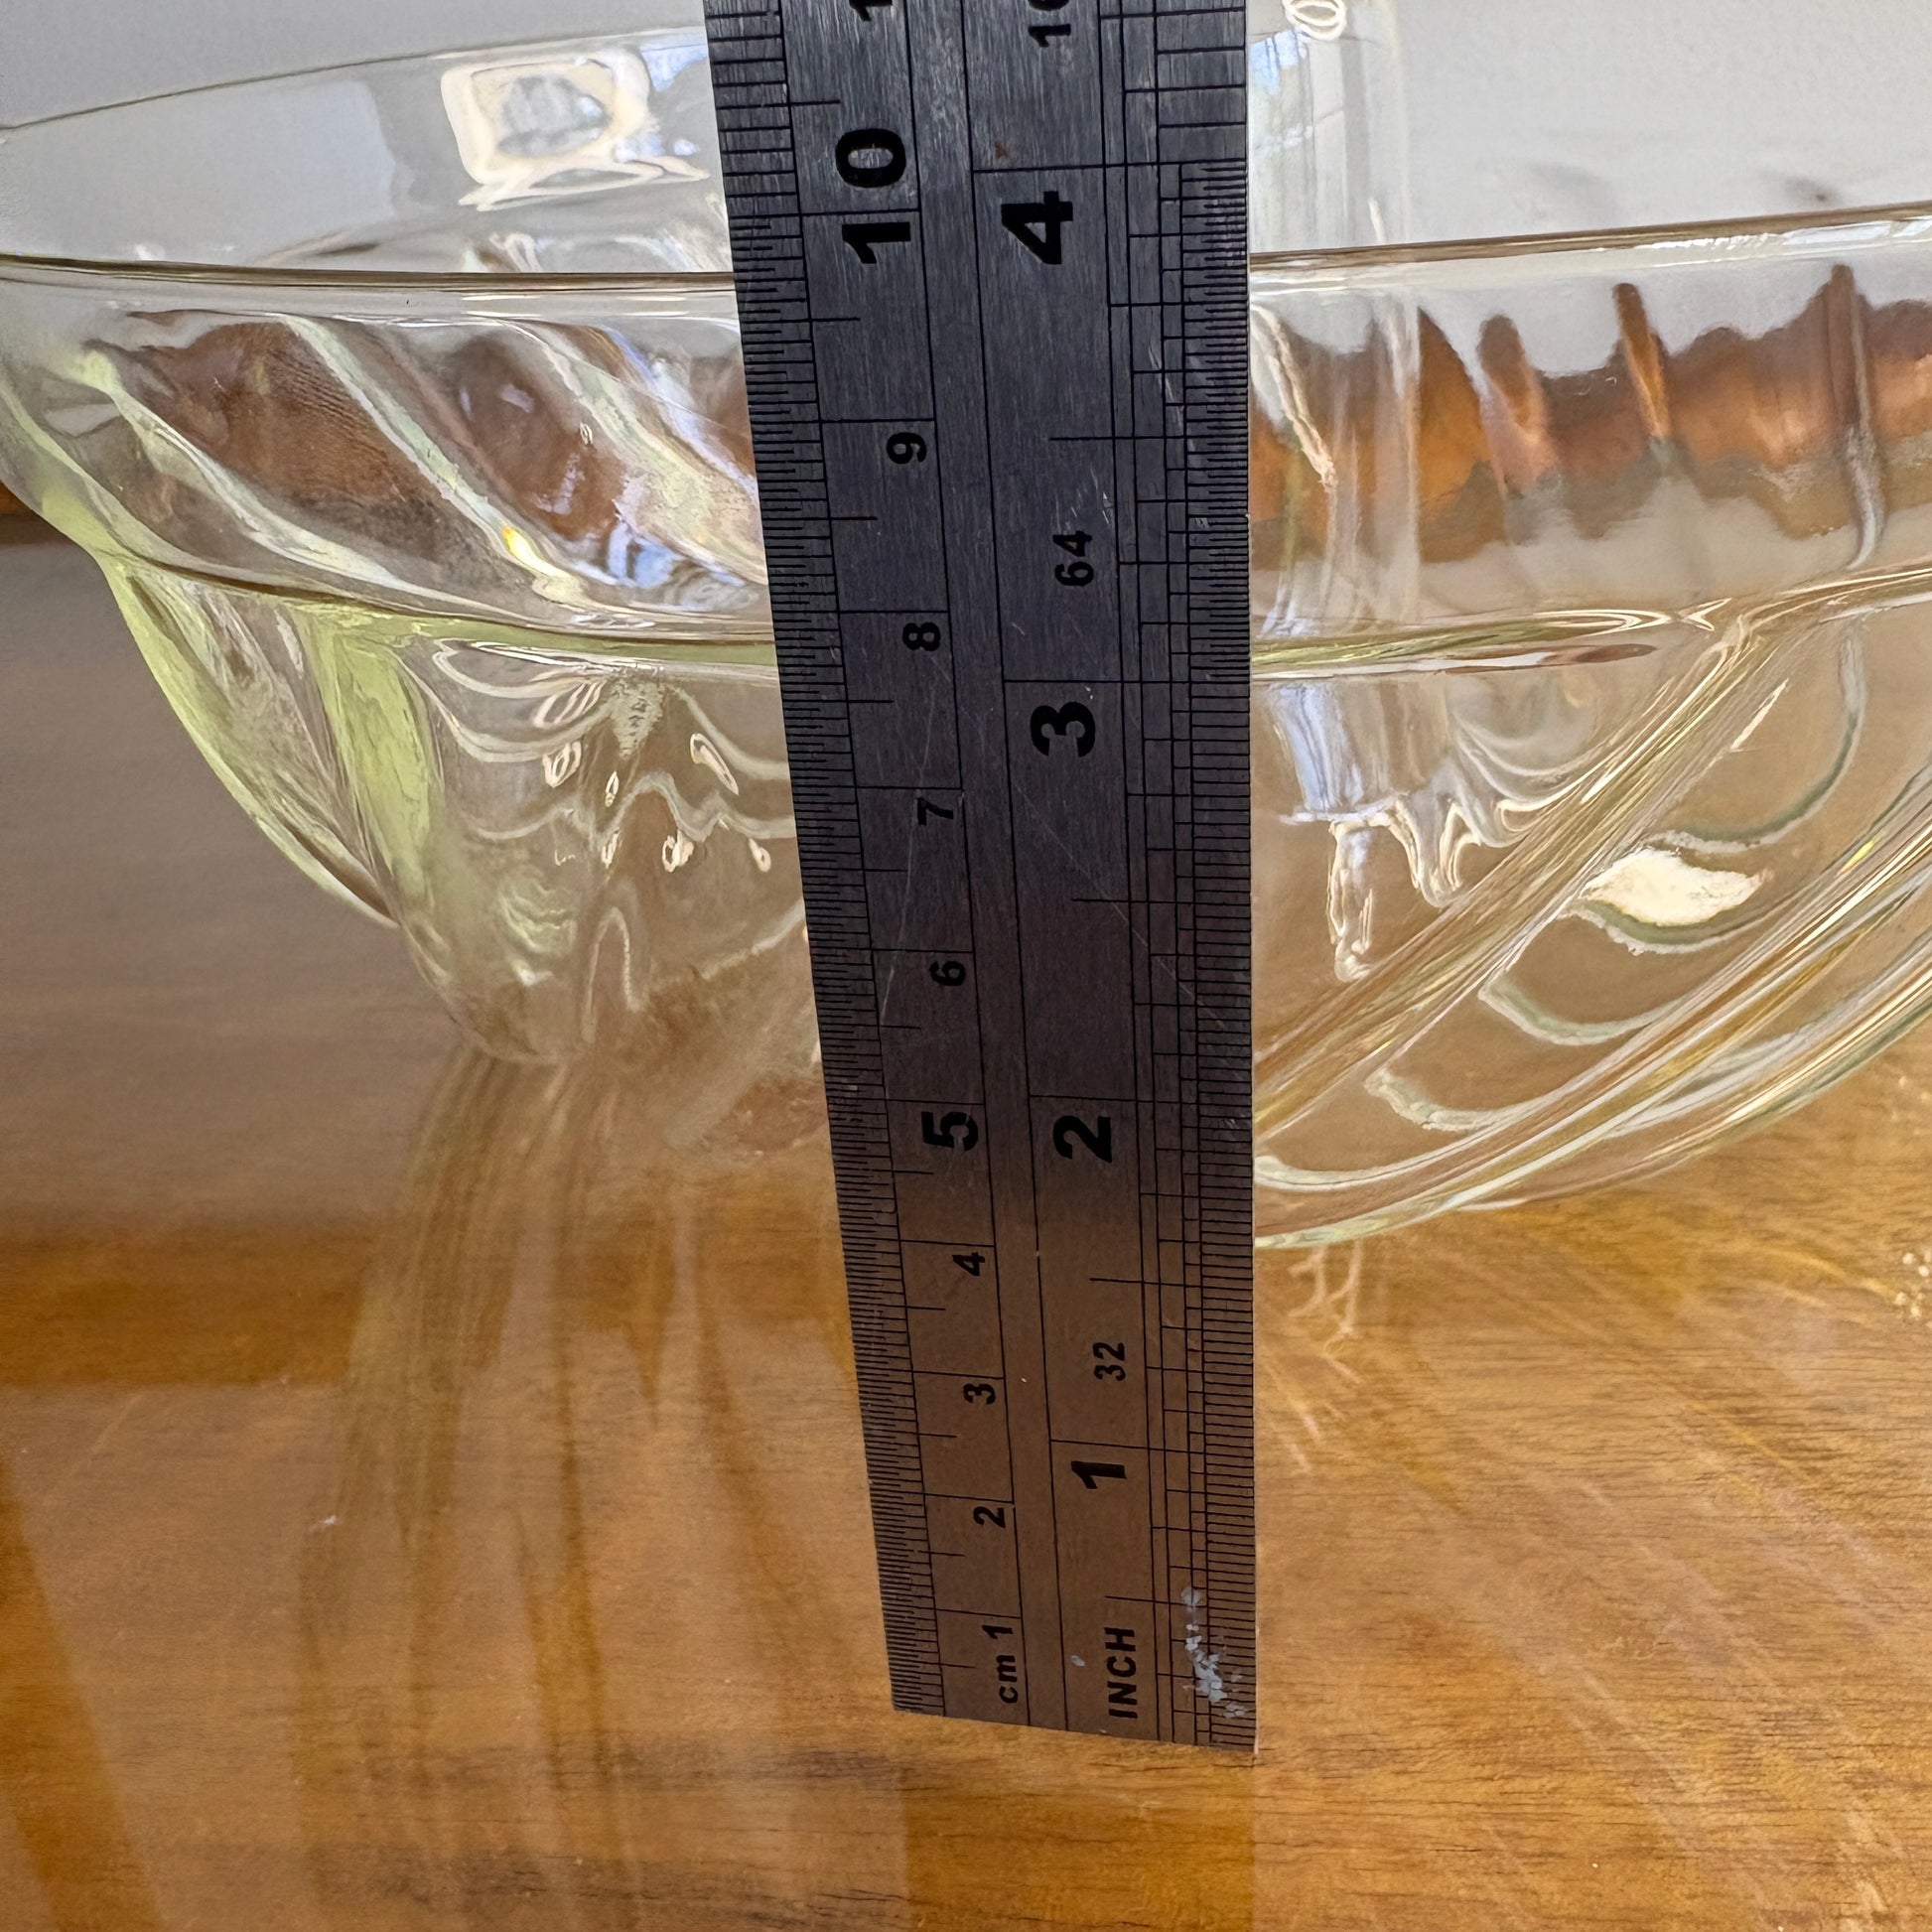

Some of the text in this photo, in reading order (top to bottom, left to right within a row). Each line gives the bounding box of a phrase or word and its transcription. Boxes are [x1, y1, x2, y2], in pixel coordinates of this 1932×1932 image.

[835, 128, 911, 265] 10
[1001, 191, 1073, 265] 4
[886, 432, 927, 464] 9
[1052, 530, 1094, 587] 64
[902, 622, 941, 652] 8
[1031, 702, 1096, 758] 3
[916, 797, 954, 826] 7
[929, 961, 966, 987] 6
[921, 1111, 979, 1152] 5
[1052, 1115, 1113, 1164] 2
[952, 1252, 986, 1277] 4
[1093, 1342, 1126, 1382] 32
[963, 1383, 997, 1405] 3
[1070, 1460, 1127, 1490] 1
[973, 1506, 1006, 1529] 2
[982, 1624, 1019, 1705] cm 1
[1104, 1626, 1139, 1720] INCH
